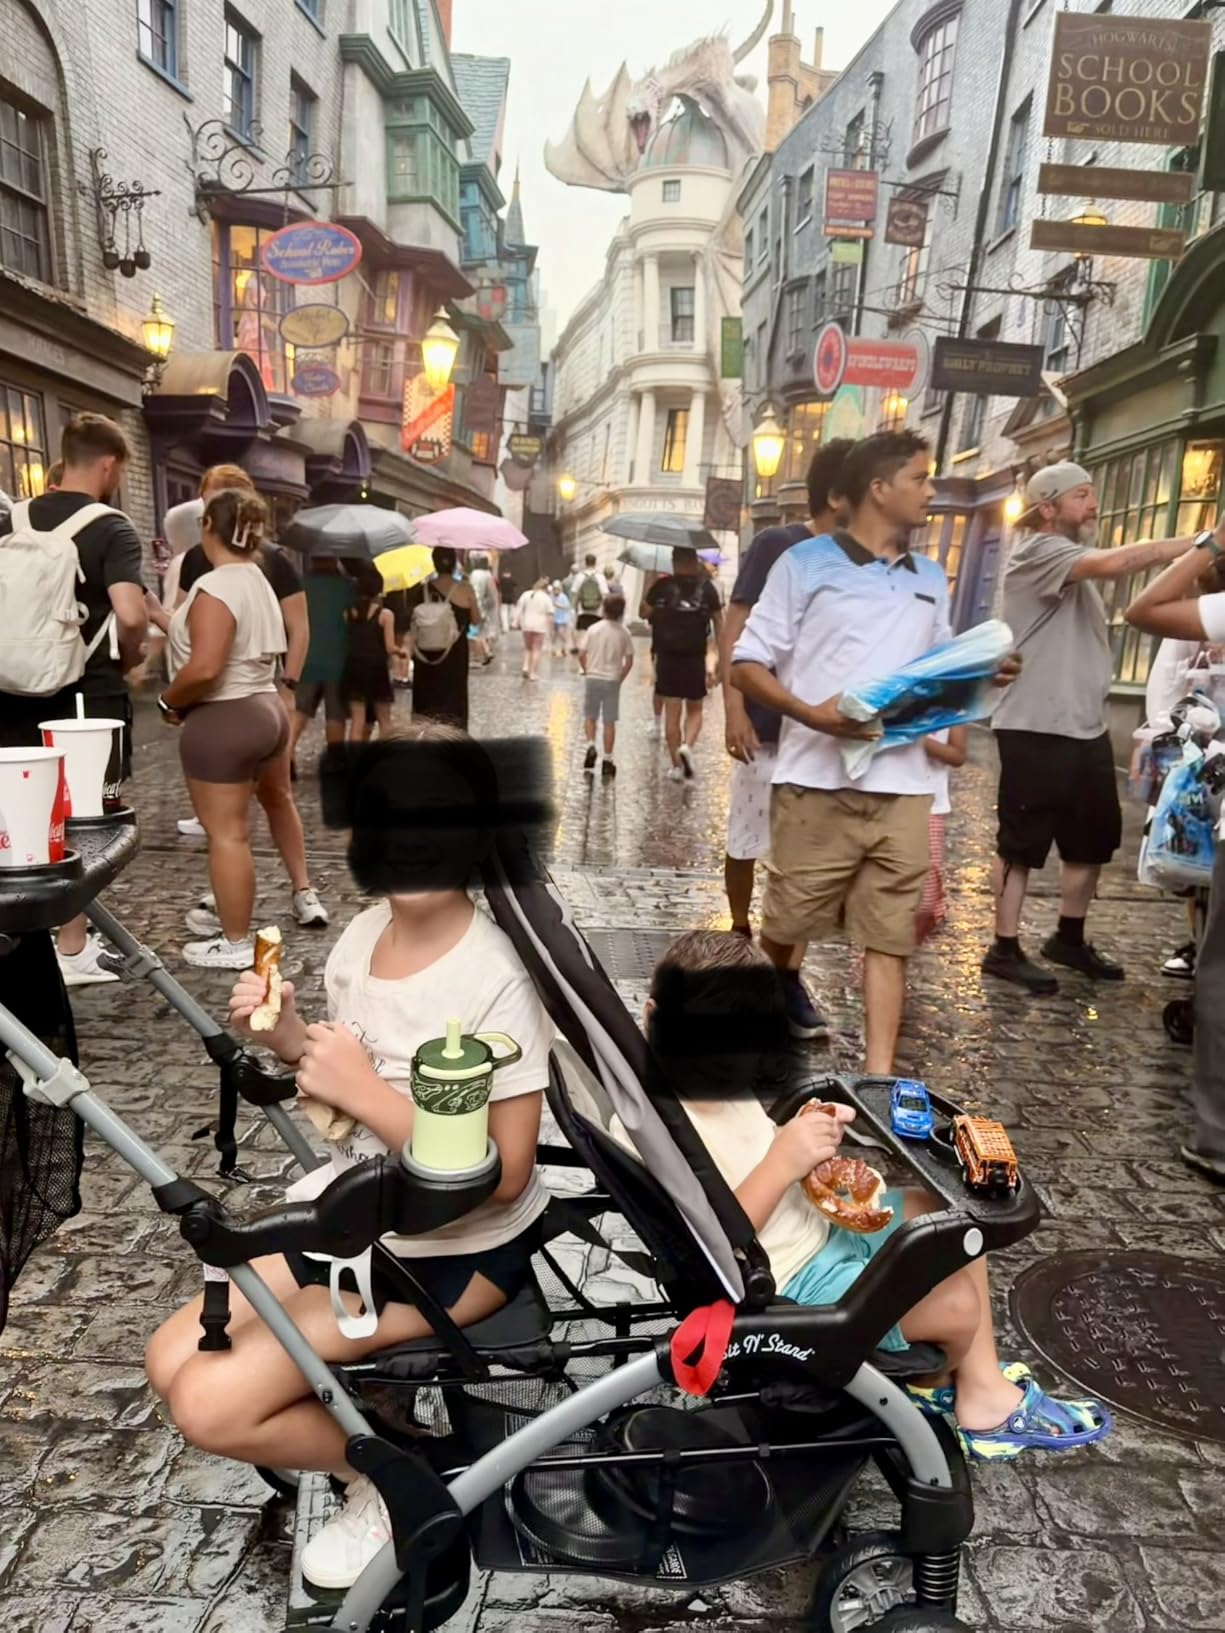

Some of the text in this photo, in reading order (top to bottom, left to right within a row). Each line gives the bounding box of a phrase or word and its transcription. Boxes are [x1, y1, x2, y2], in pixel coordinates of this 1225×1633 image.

[1057, 54, 1200, 88] SCHOOL
[1053, 83, 1199, 125] BOOKS
[761, 1333, 814, 1361] Stand
